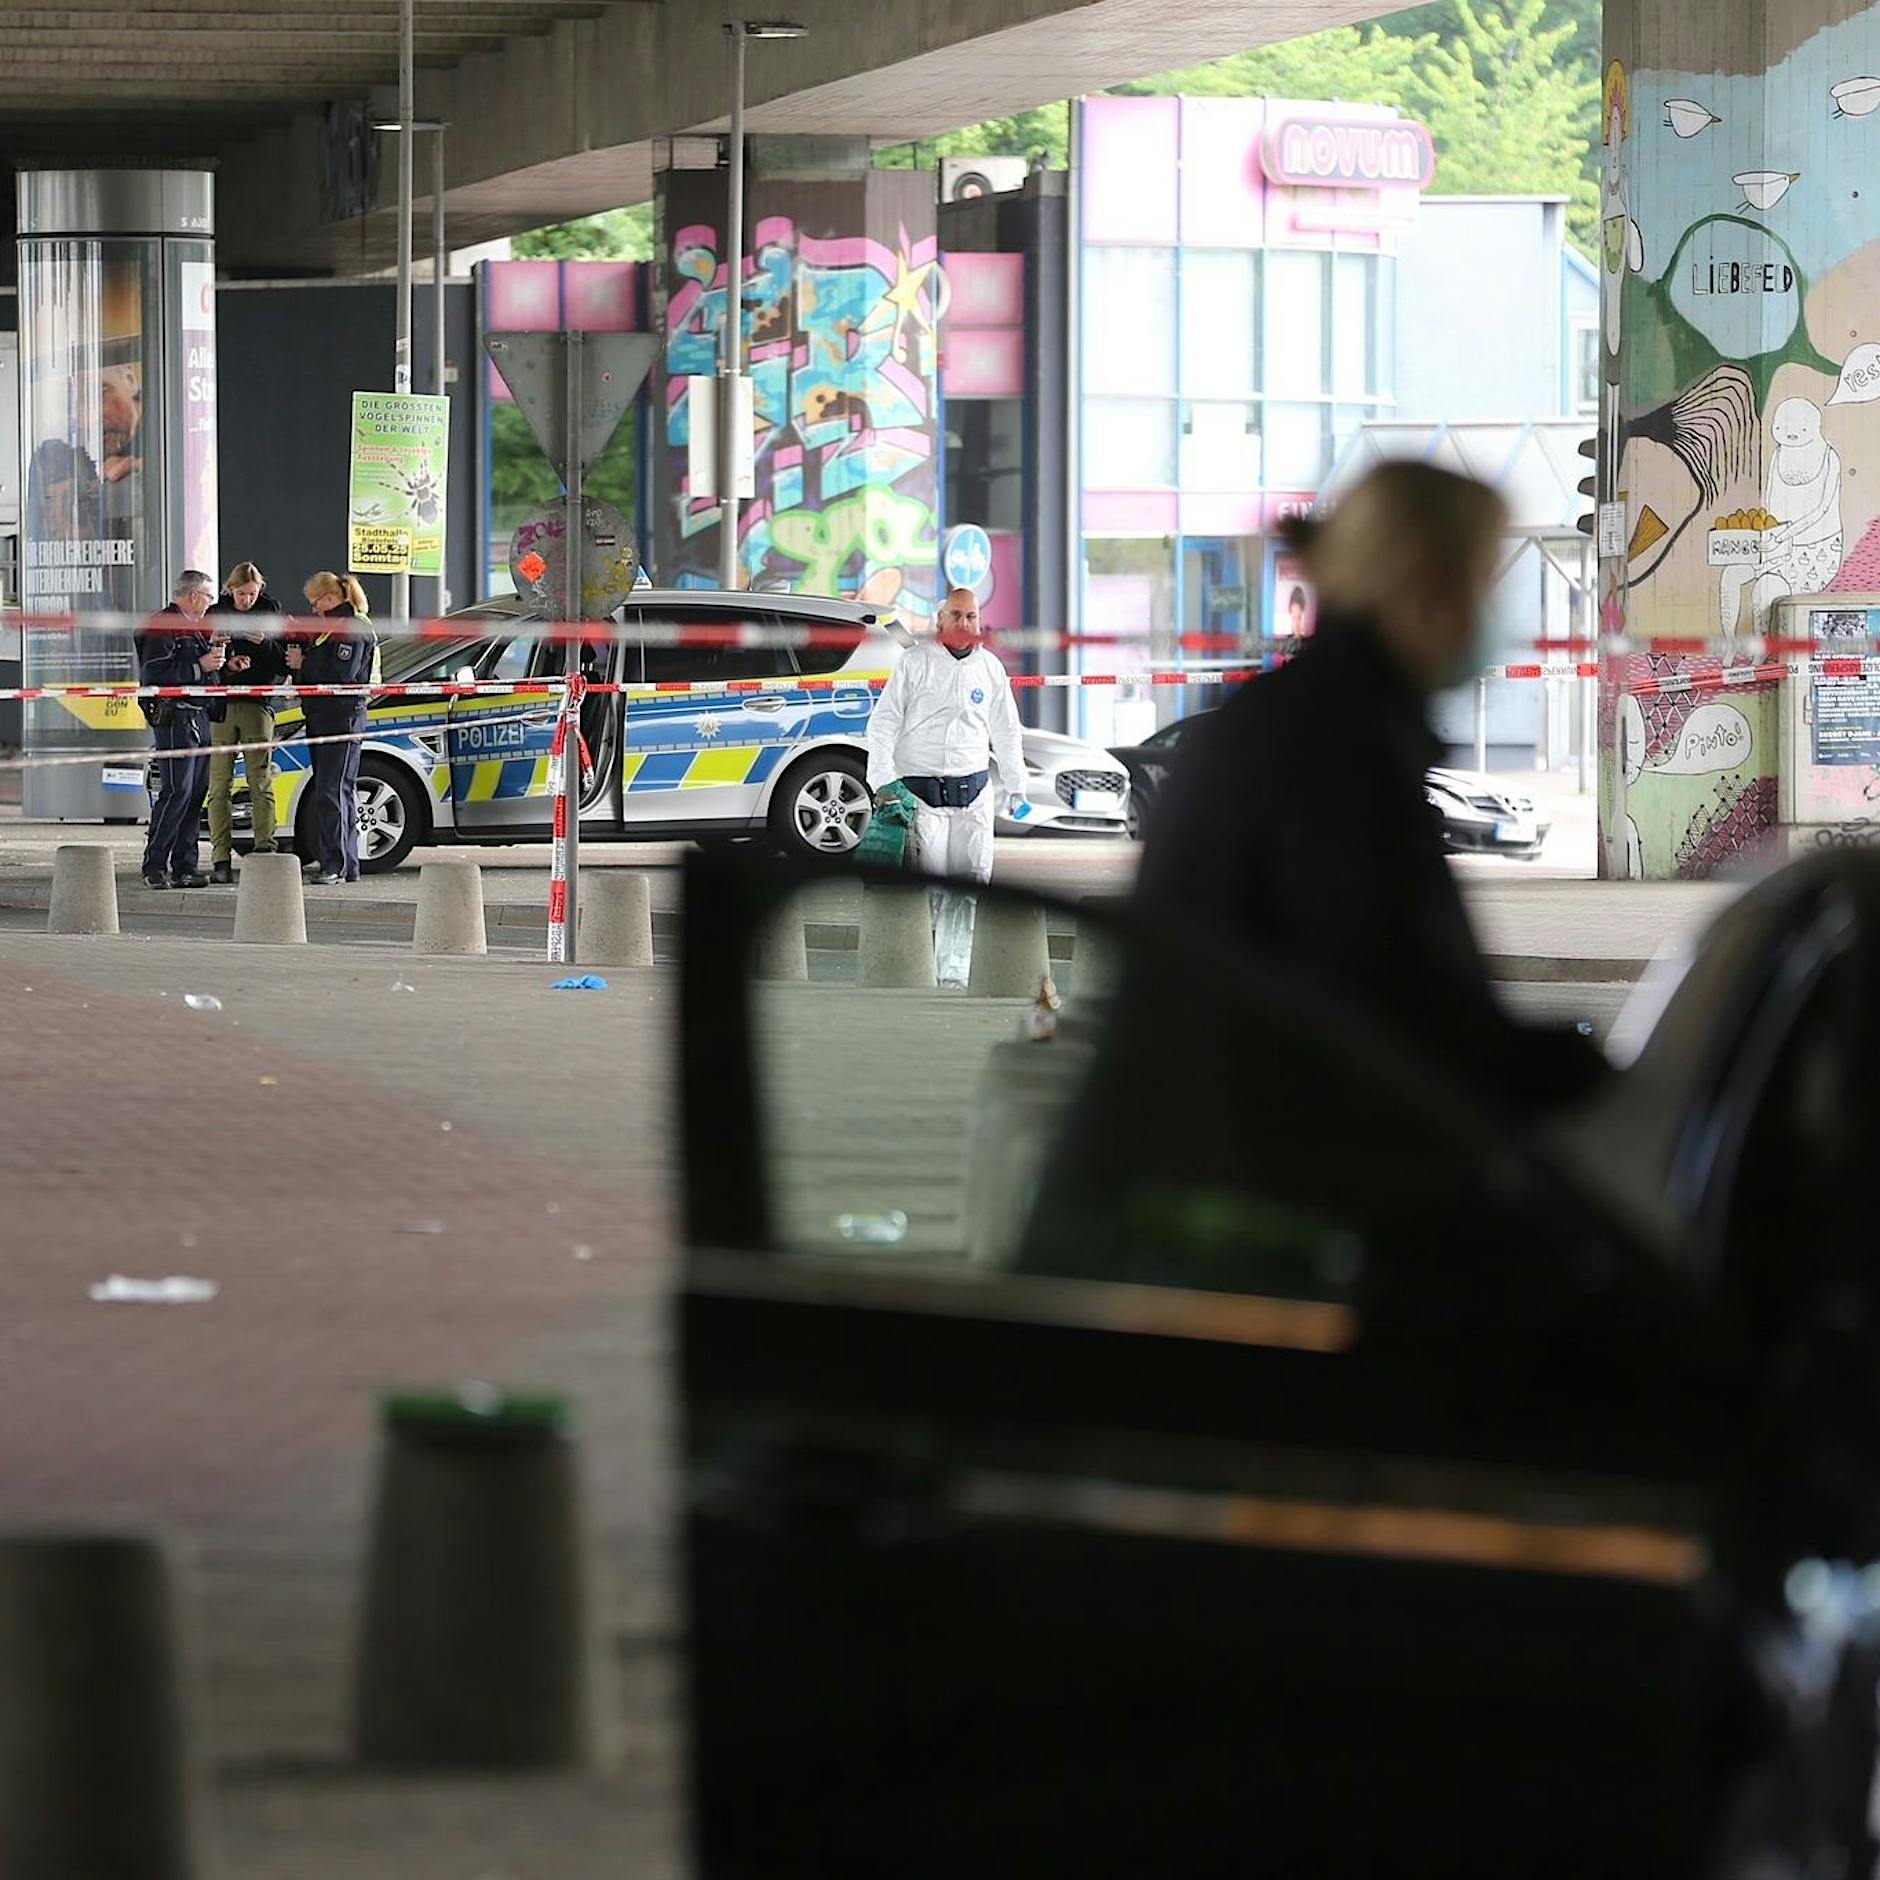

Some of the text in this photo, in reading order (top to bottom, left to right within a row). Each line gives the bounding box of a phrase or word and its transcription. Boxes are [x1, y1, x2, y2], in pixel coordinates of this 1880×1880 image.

[361, 401, 380, 409] DIE
[359, 412, 443, 423] VOGELSPINNEN
[353, 554, 408, 566] Sonntag
[457, 723, 525, 750] POLIZEI
